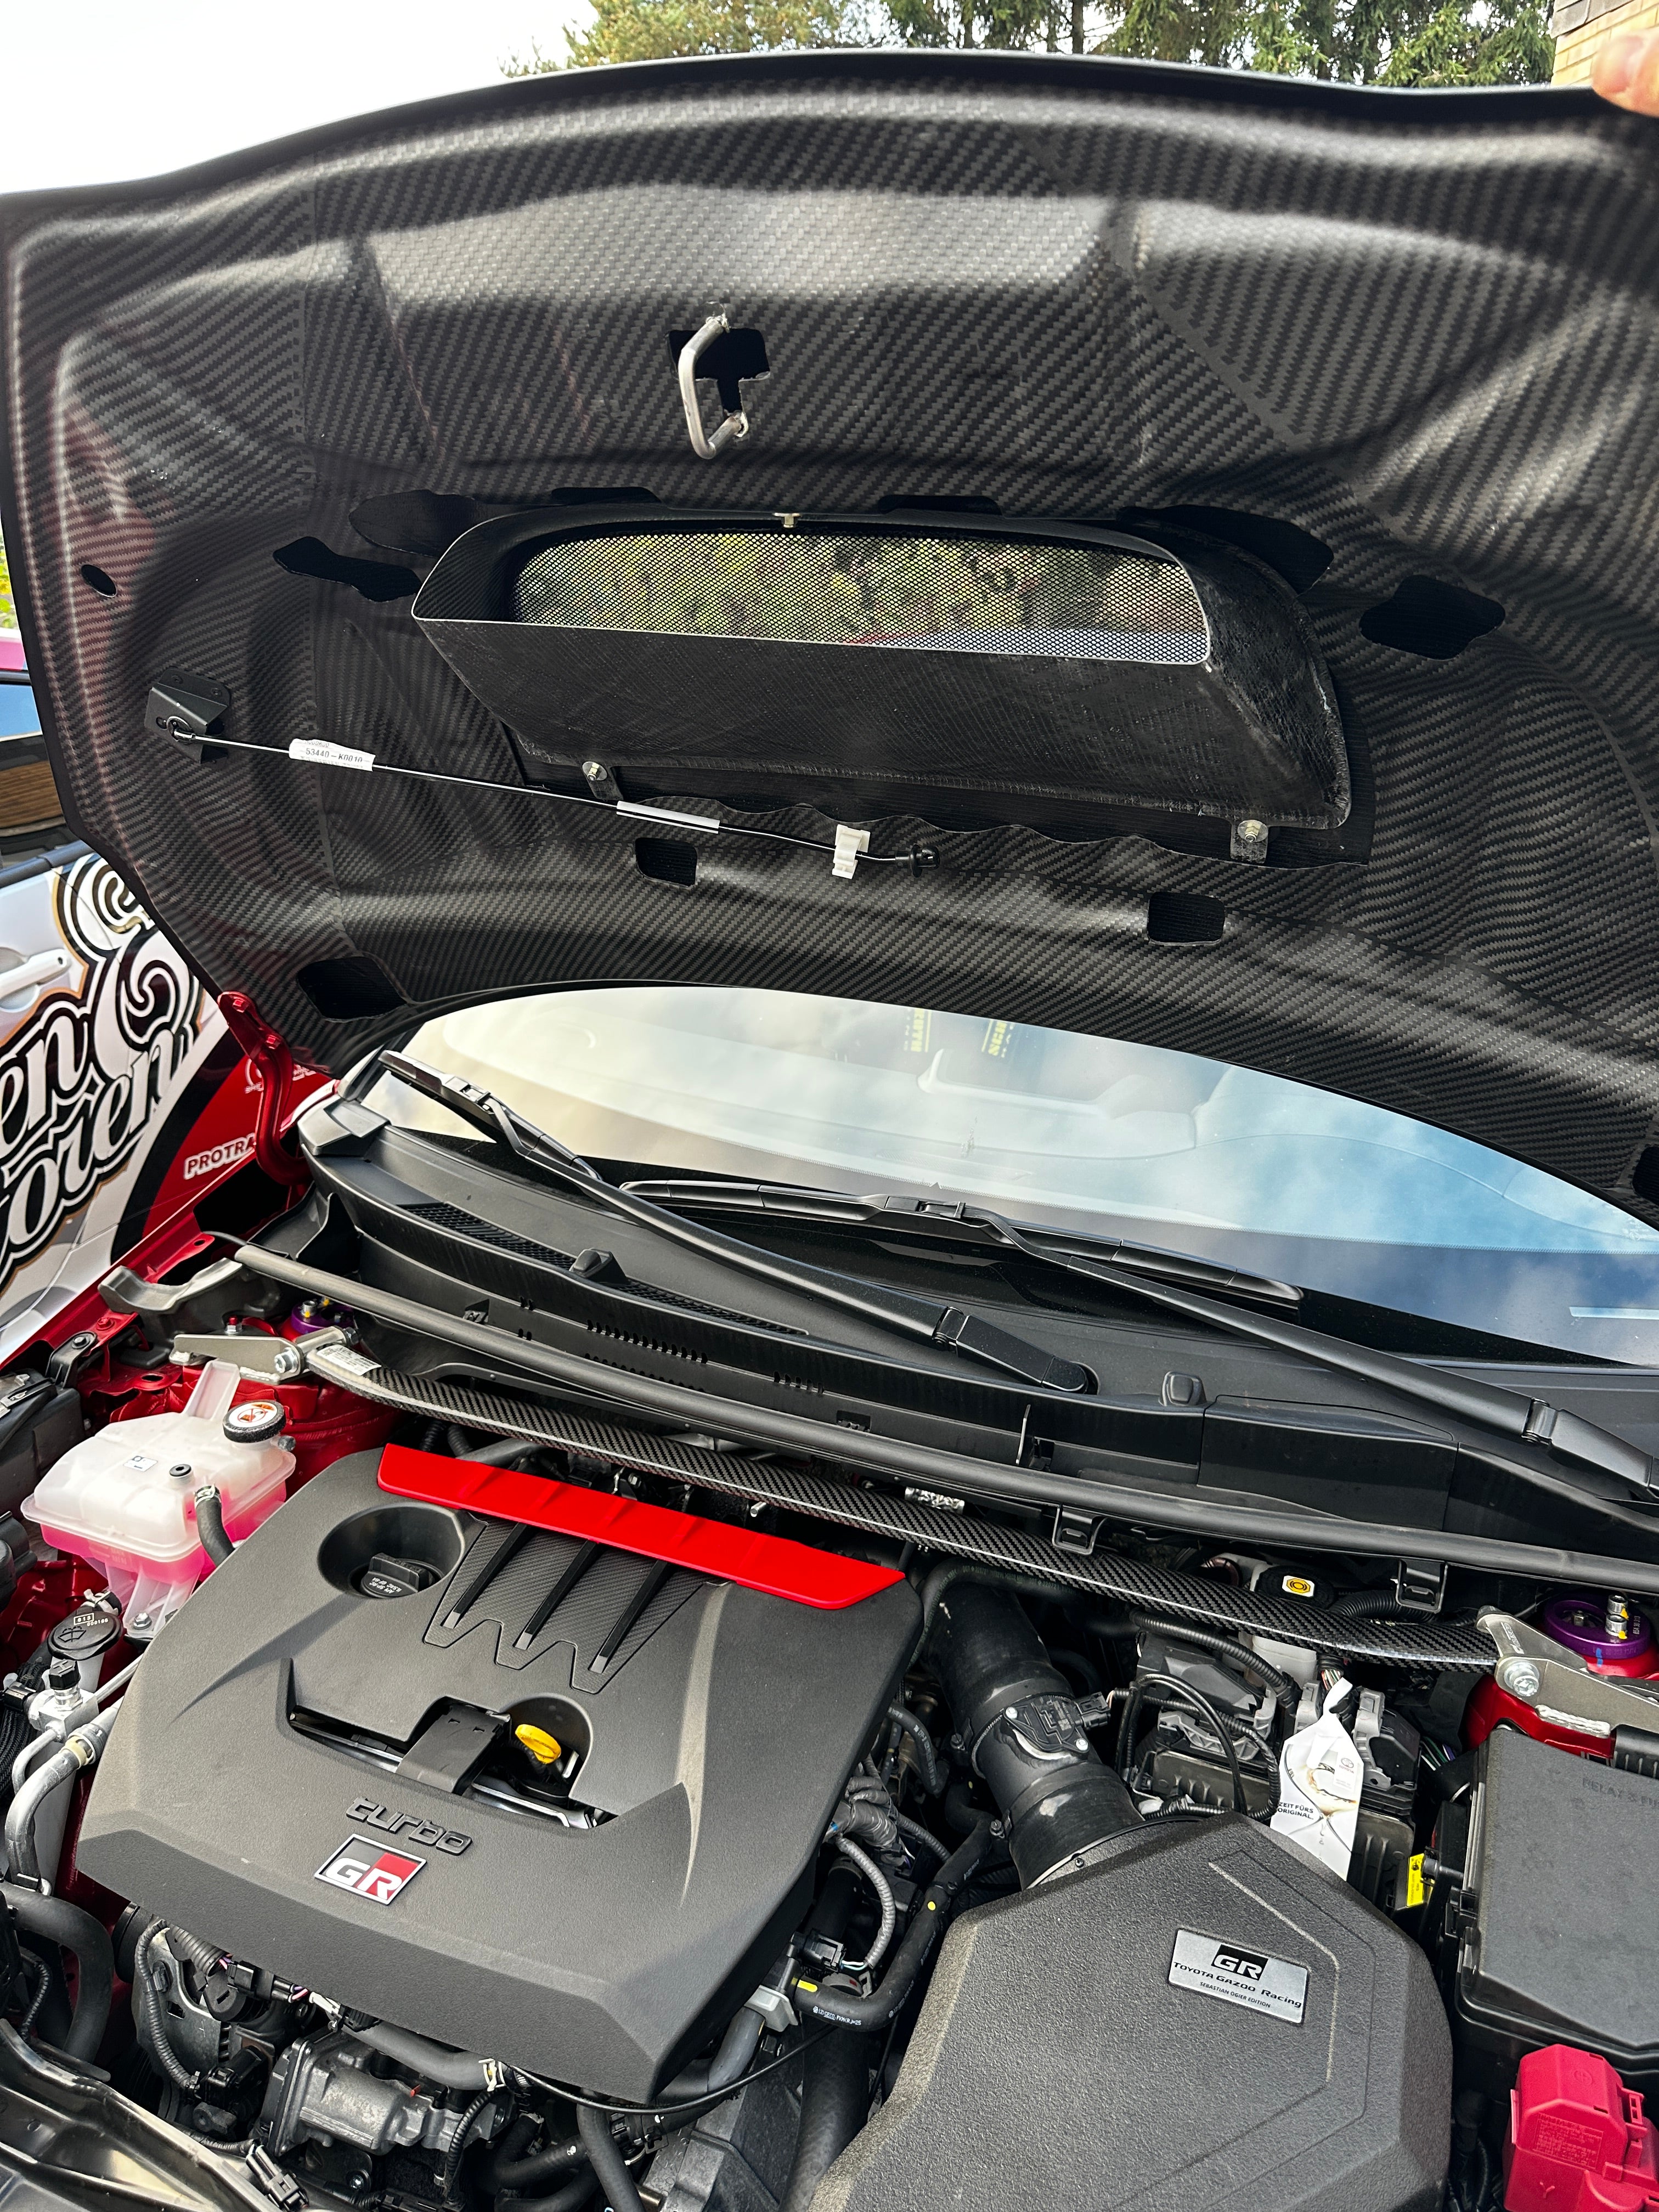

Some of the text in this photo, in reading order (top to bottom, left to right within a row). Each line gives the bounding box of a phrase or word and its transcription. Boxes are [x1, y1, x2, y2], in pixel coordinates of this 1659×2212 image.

[346, 1796, 472, 1856] turbo
[1295, 1804, 1313, 1814] FÜRS
[326, 1857, 403, 1900] GR
[1213, 1954, 1263, 1979] GR
[1173, 1961, 1214, 1978] TOYOTA
[1261, 1989, 1302, 2008] Racing
[1230, 1990, 1247, 2001] OGIER
[1248, 1997, 1271, 2008] EDITION
